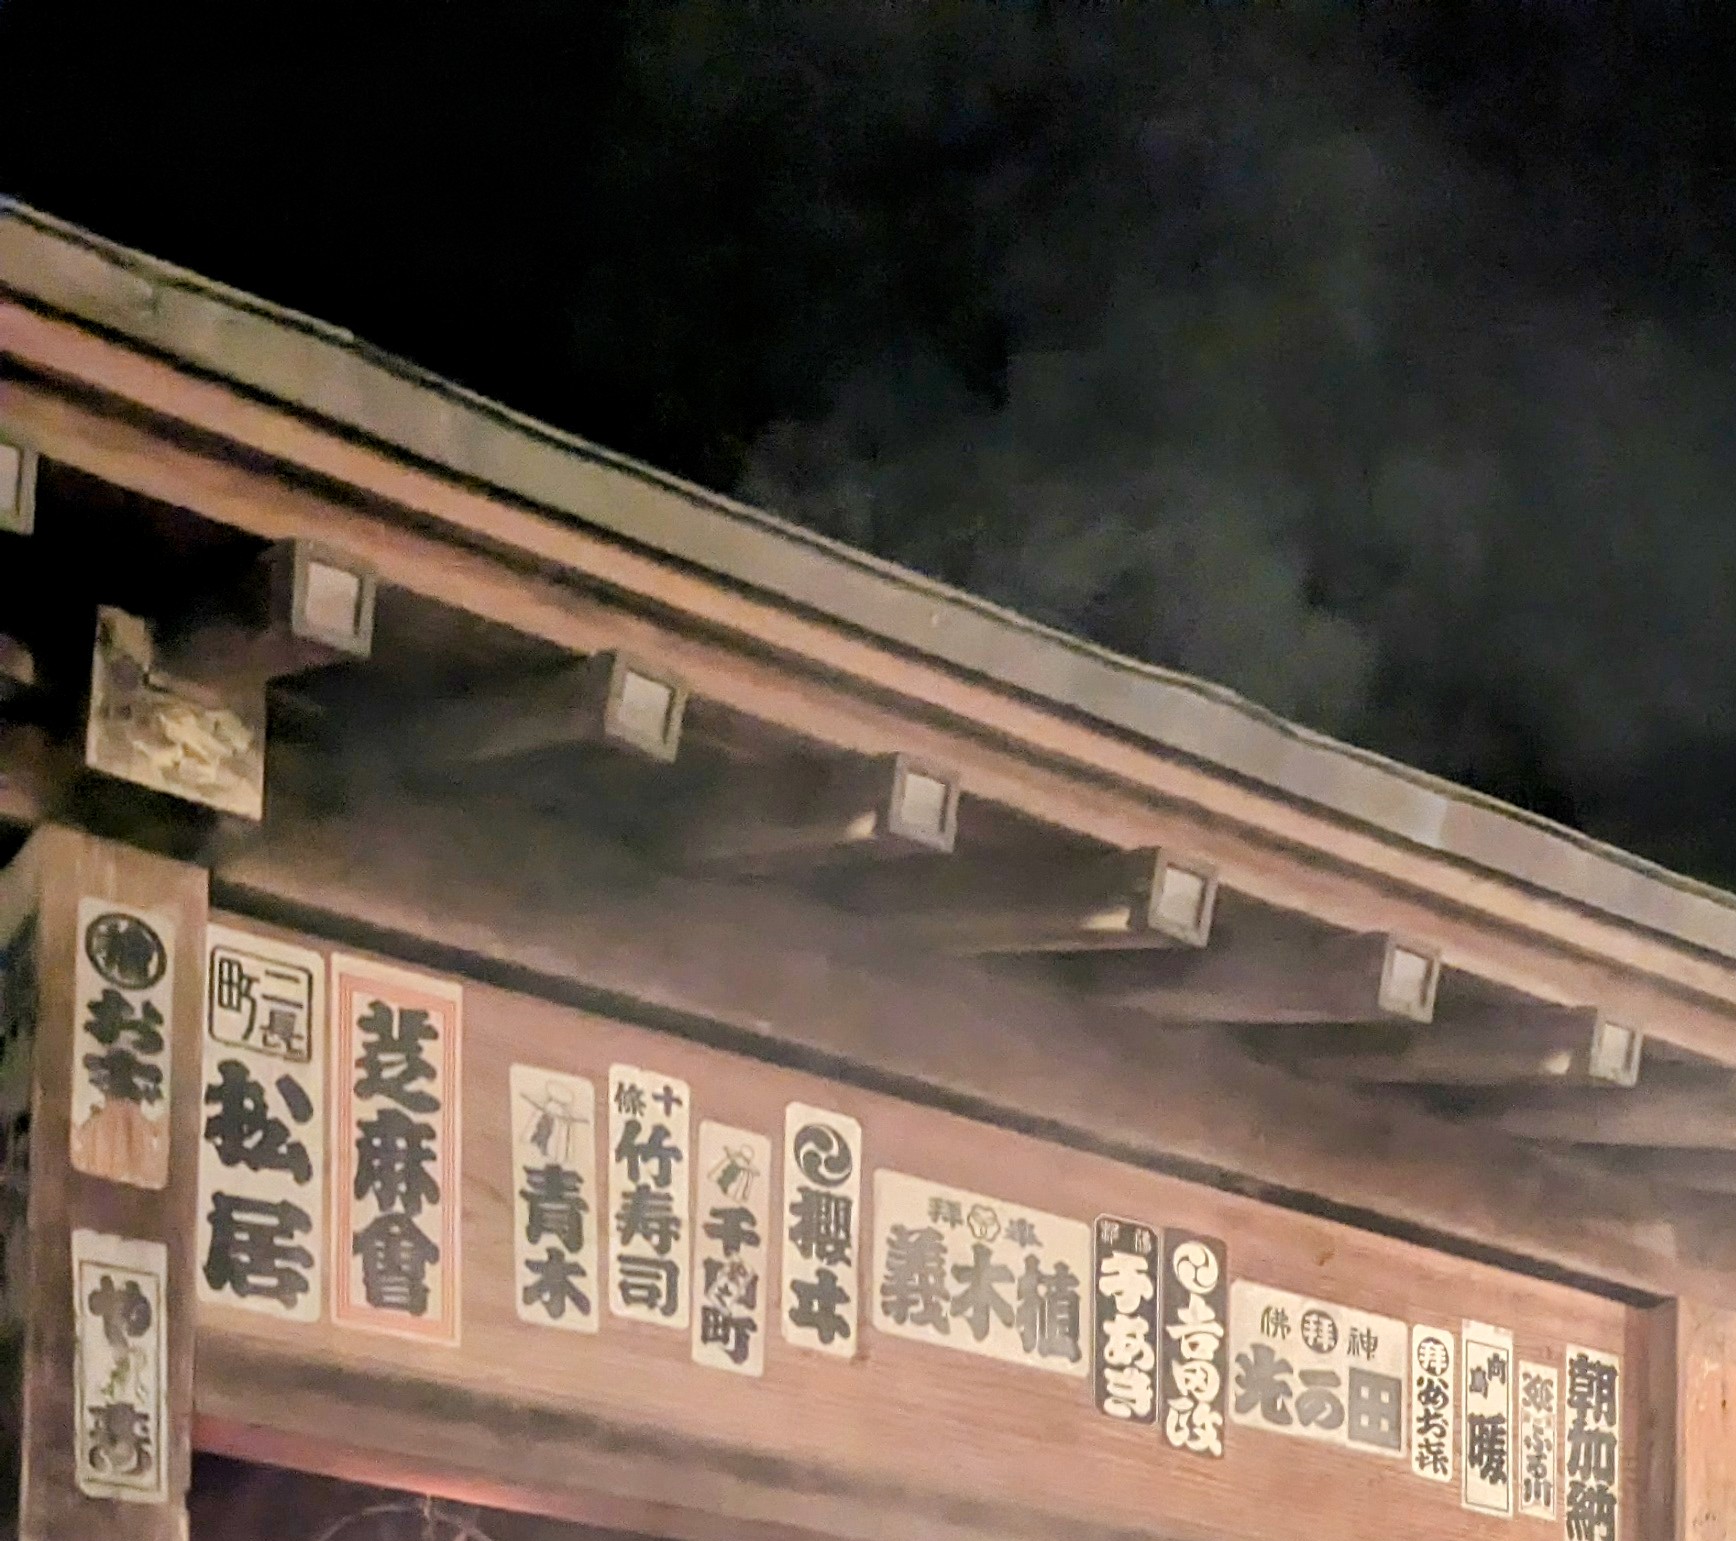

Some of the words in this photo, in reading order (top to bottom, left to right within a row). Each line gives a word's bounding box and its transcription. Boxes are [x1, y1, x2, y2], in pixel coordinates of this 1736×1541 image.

[203, 1059, 314, 1310] 松居
[518, 1163, 591, 1320] 青木
[615, 1119, 683, 1318] 竹寿司
